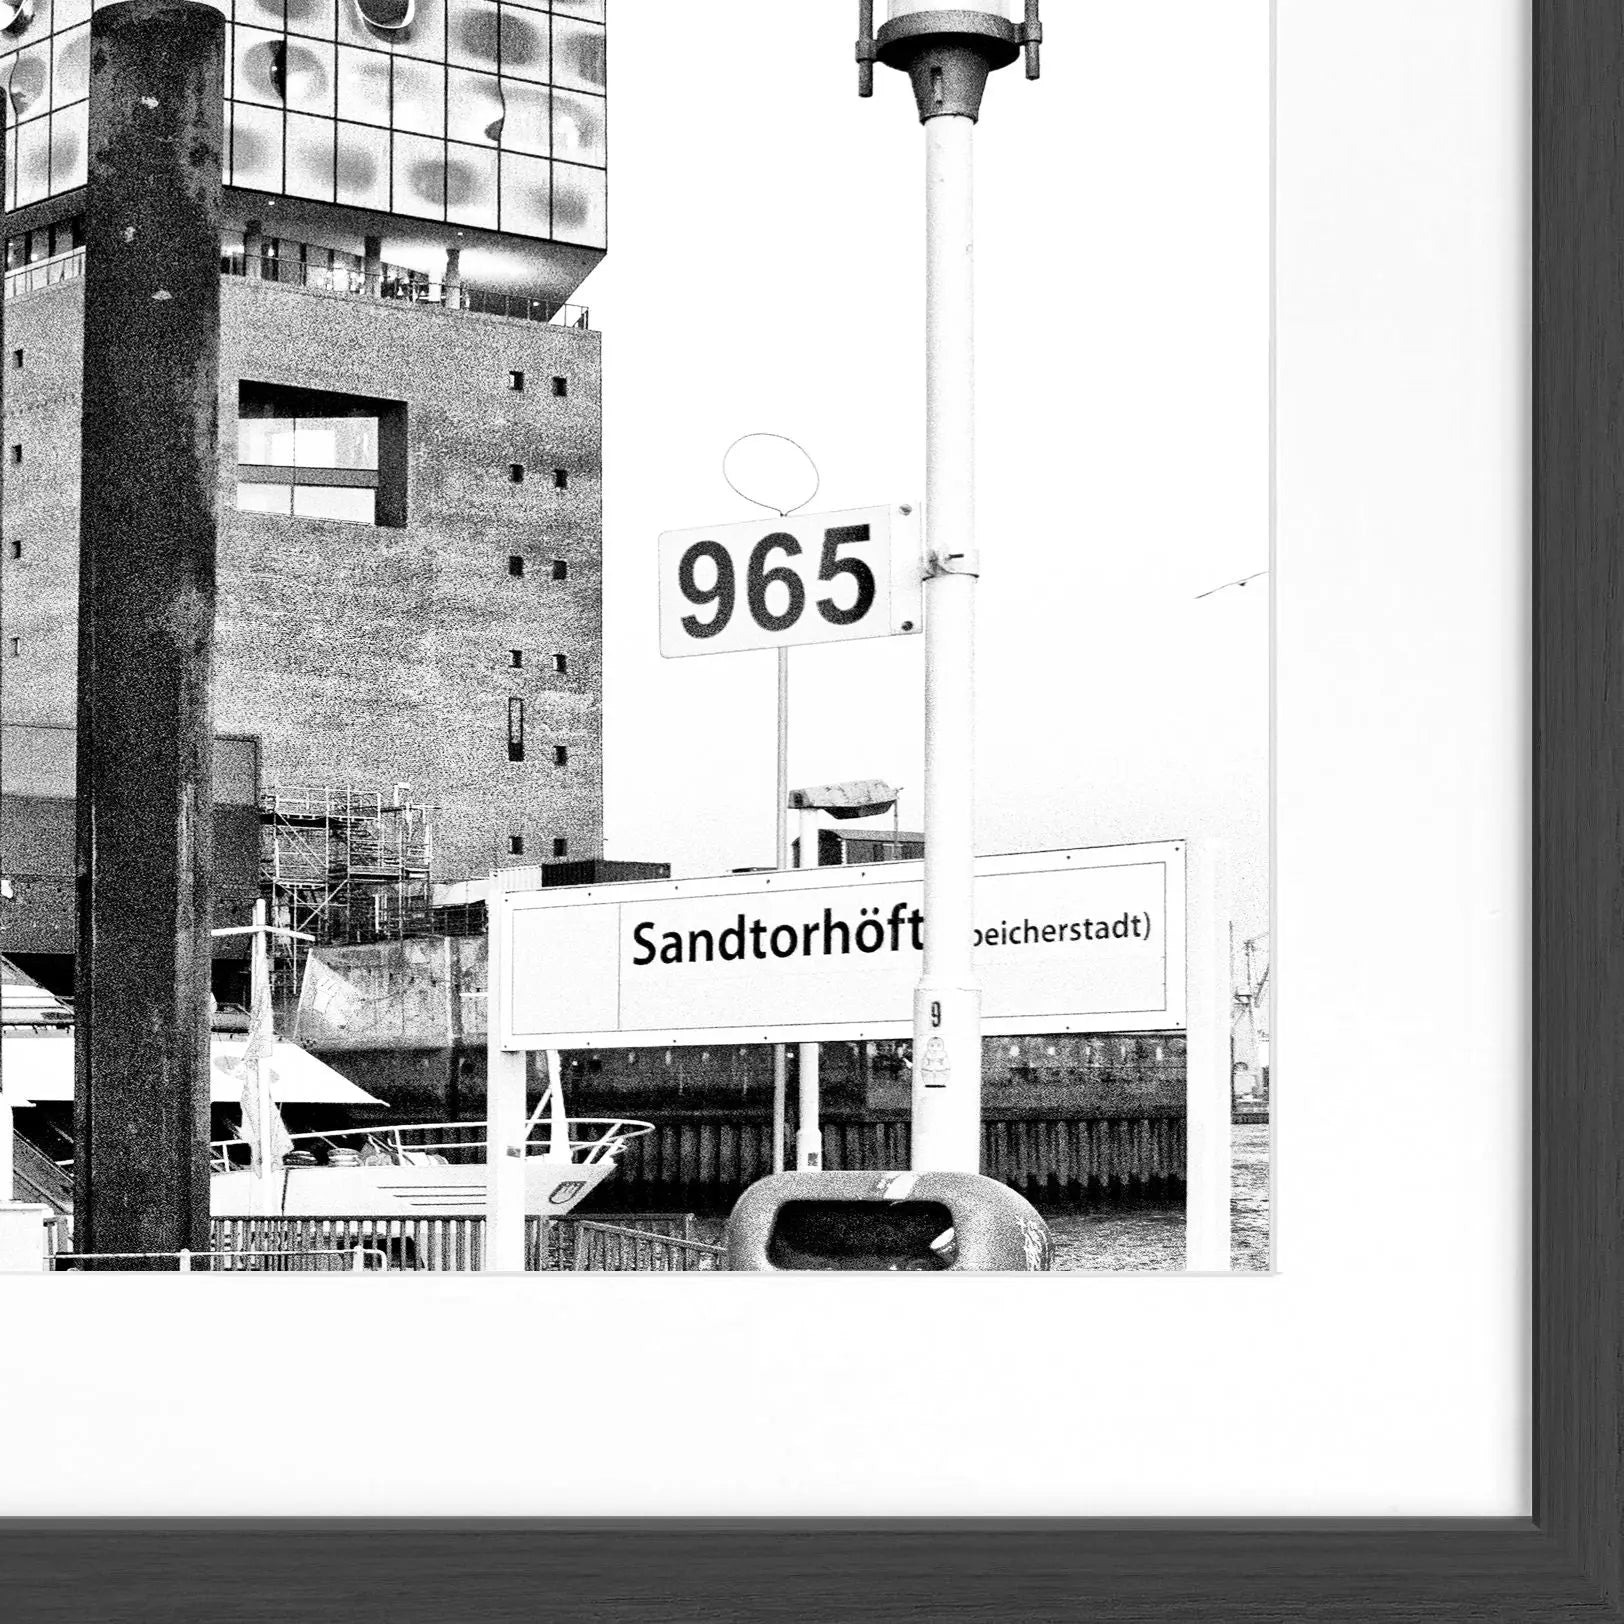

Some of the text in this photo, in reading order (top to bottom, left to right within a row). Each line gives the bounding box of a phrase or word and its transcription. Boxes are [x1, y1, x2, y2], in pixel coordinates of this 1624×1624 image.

[678, 523, 876, 640] 965
[632, 901, 925, 966] Sandtorhöft
[930, 1000, 942, 1028] 9
